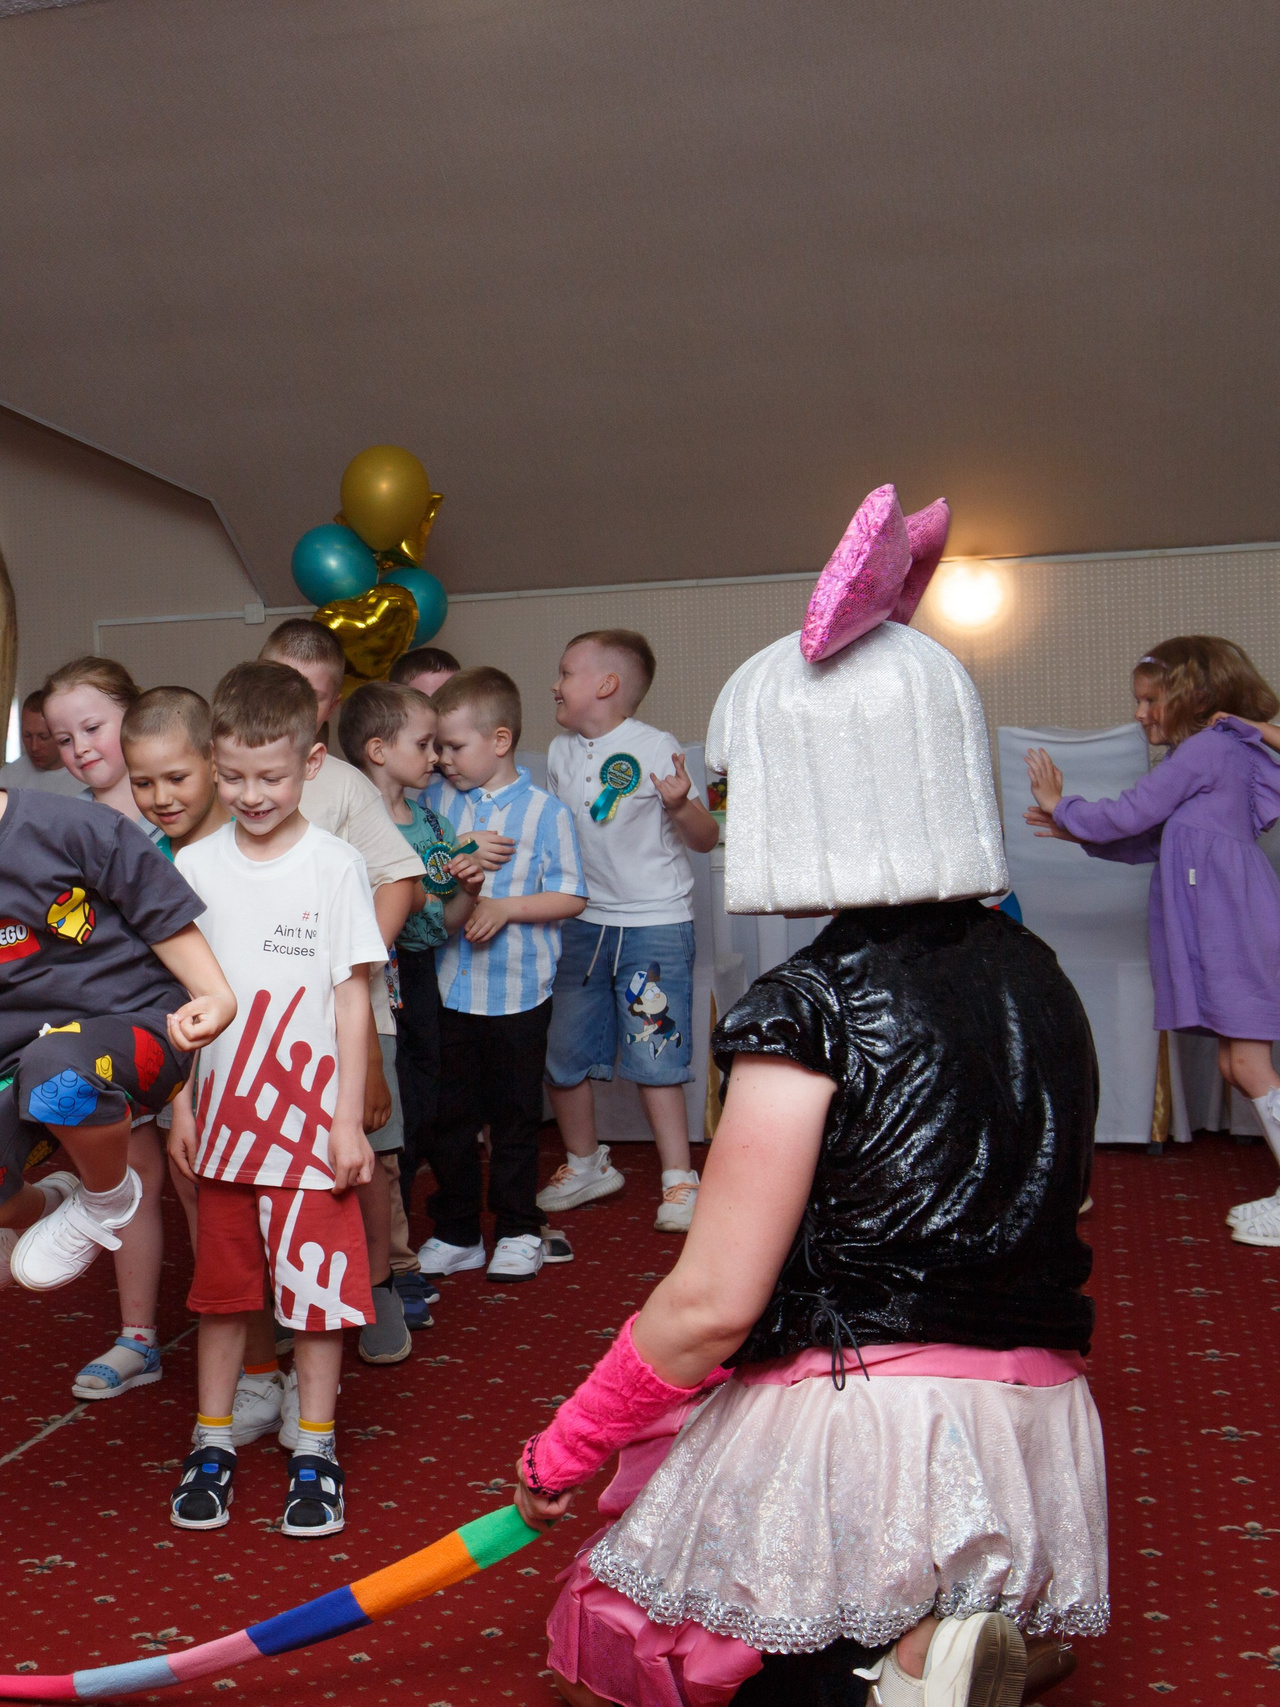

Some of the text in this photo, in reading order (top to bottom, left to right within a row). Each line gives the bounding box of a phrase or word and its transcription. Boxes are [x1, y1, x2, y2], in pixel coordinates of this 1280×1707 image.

[302, 911, 319, 923] # 1
[273, 924, 302, 939] Ain't
[262, 940, 316, 957] Excuses
